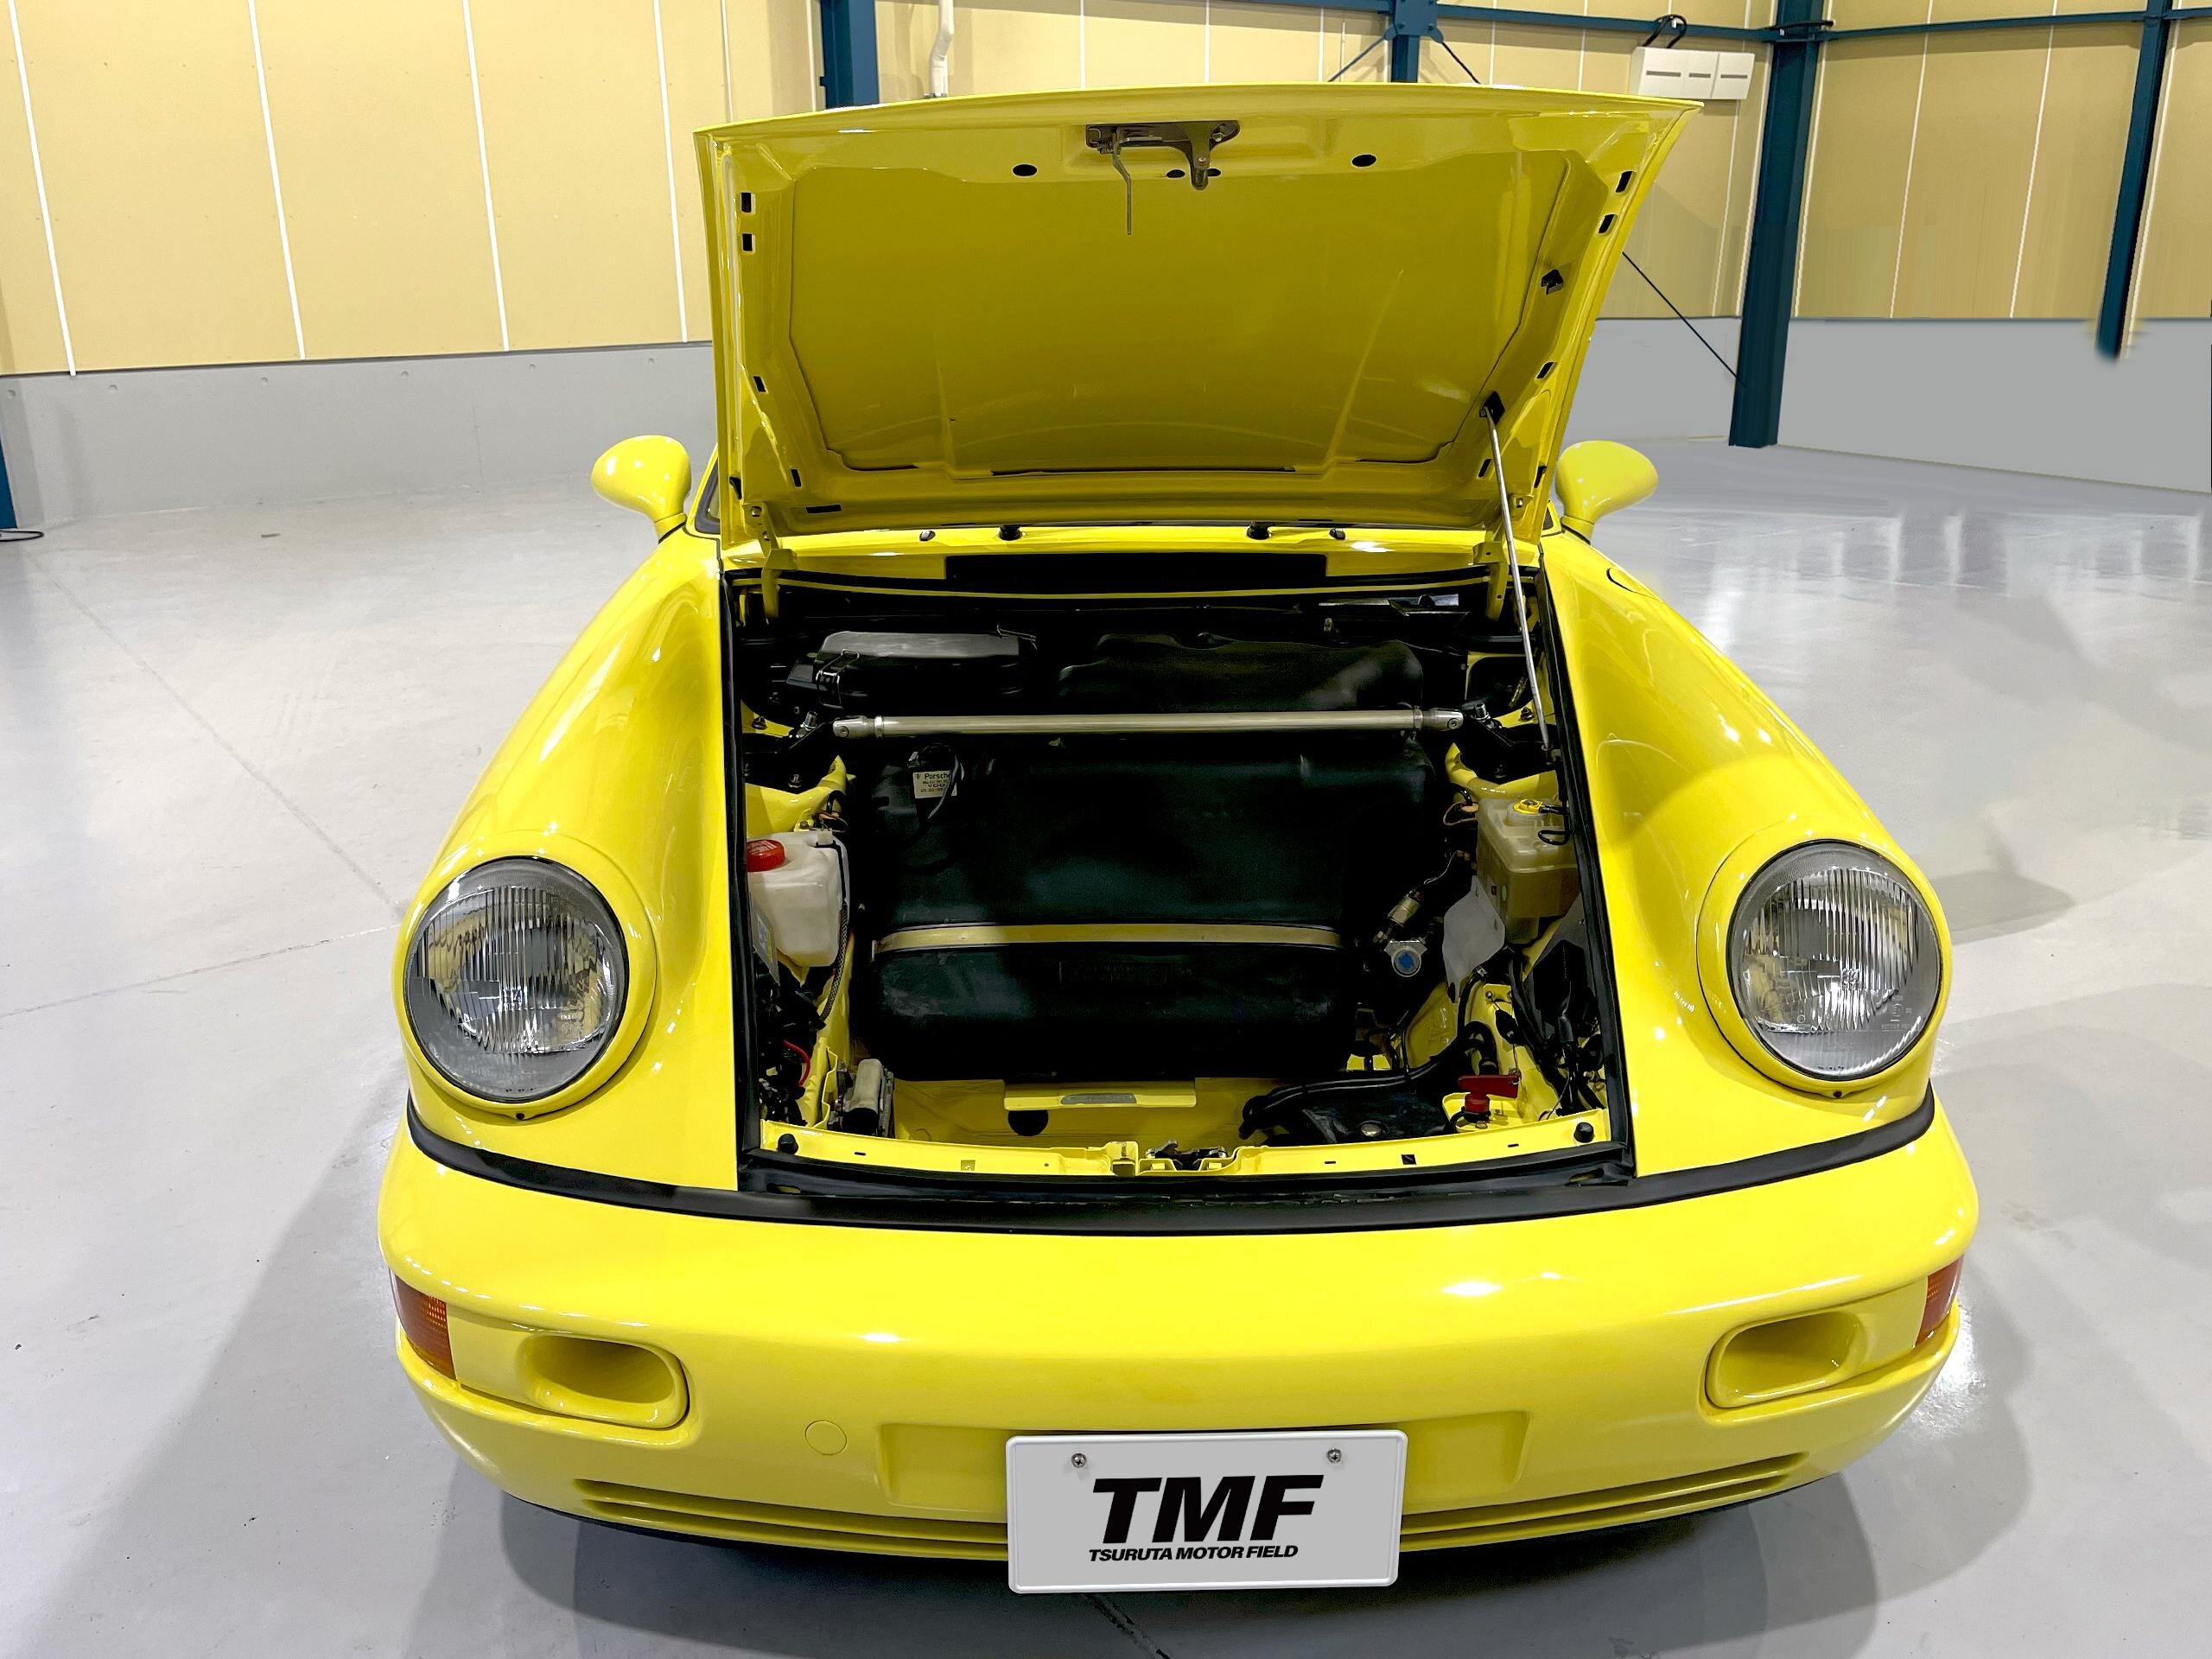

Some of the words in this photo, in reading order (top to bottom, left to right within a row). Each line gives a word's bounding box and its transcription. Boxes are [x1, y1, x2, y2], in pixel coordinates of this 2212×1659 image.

[1093, 1474, 1324, 1543] TMF
[1089, 1548, 1173, 1561] TSURUTA
[1175, 1547, 1244, 1560] MOTOR
[1245, 1545, 1299, 1559] FIELD
